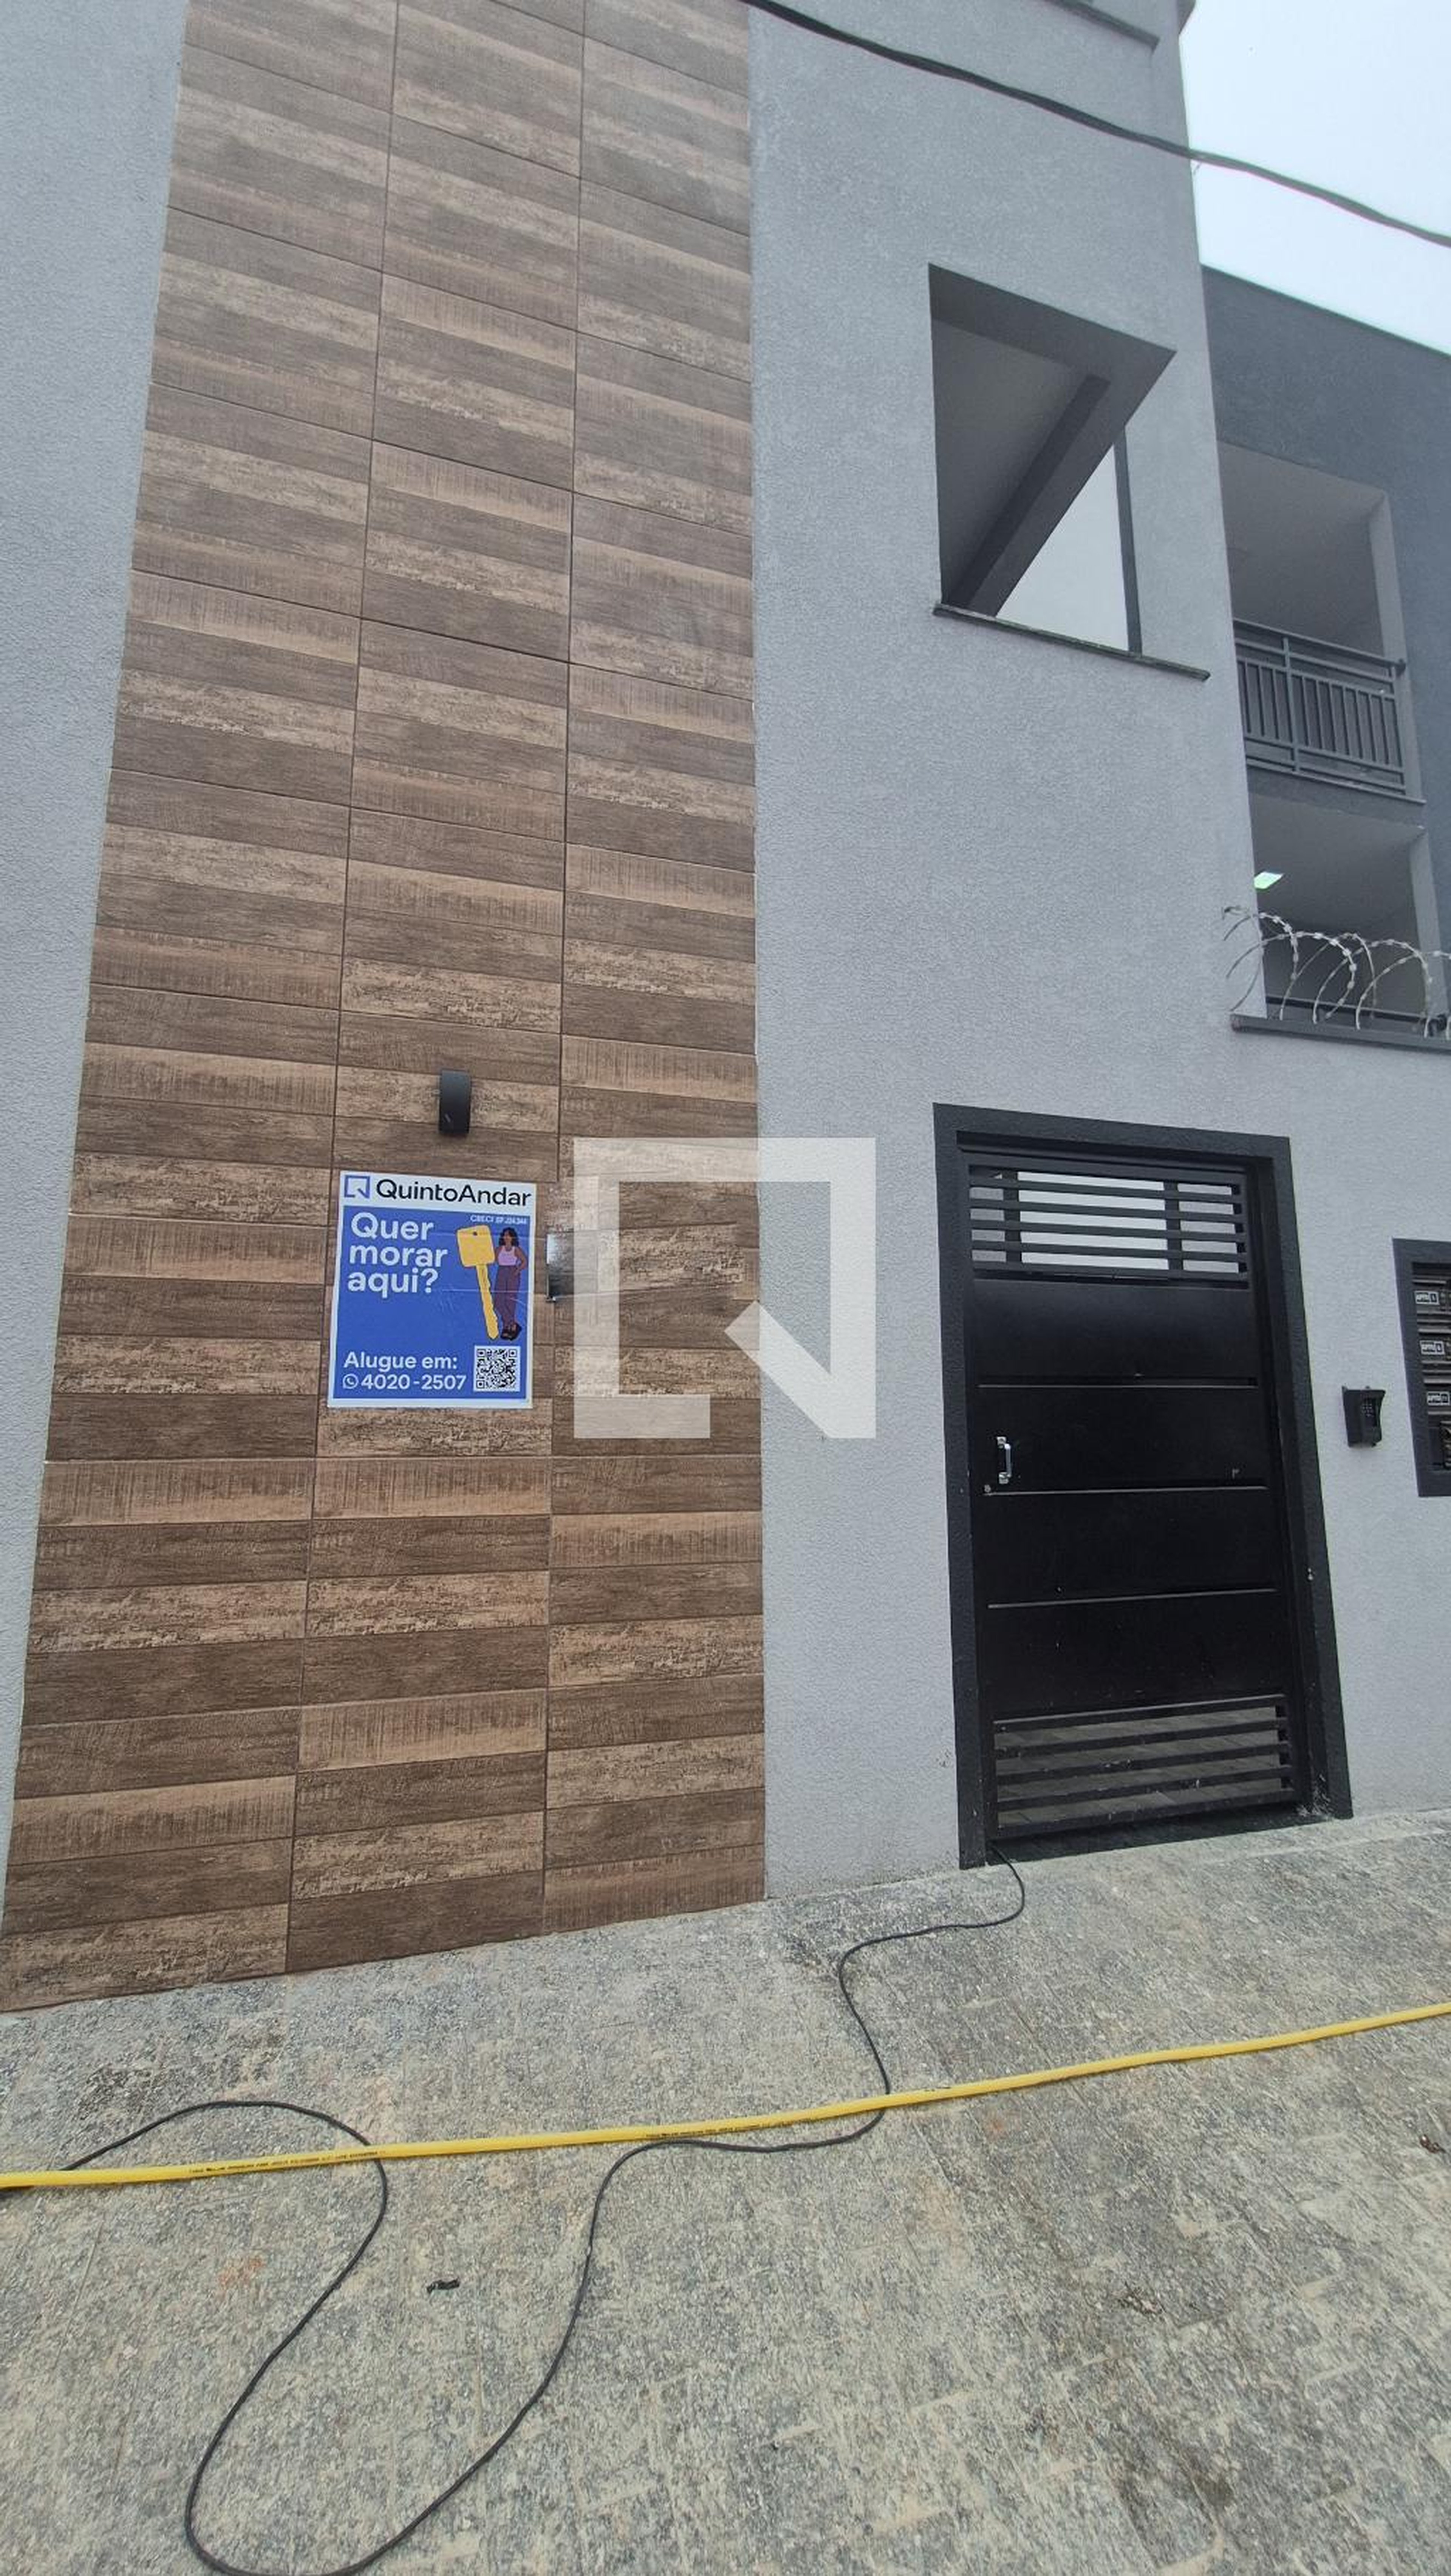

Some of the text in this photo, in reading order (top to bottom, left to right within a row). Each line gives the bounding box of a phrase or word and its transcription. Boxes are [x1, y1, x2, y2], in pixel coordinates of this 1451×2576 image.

[376, 1179, 531, 1206] QuintoAndar
[351, 1212, 434, 1240] Quer
[350, 1245, 448, 1267] morar
[348, 1267, 438, 1298] aqui?
[343, 1351, 457, 1372] Alugue em:
